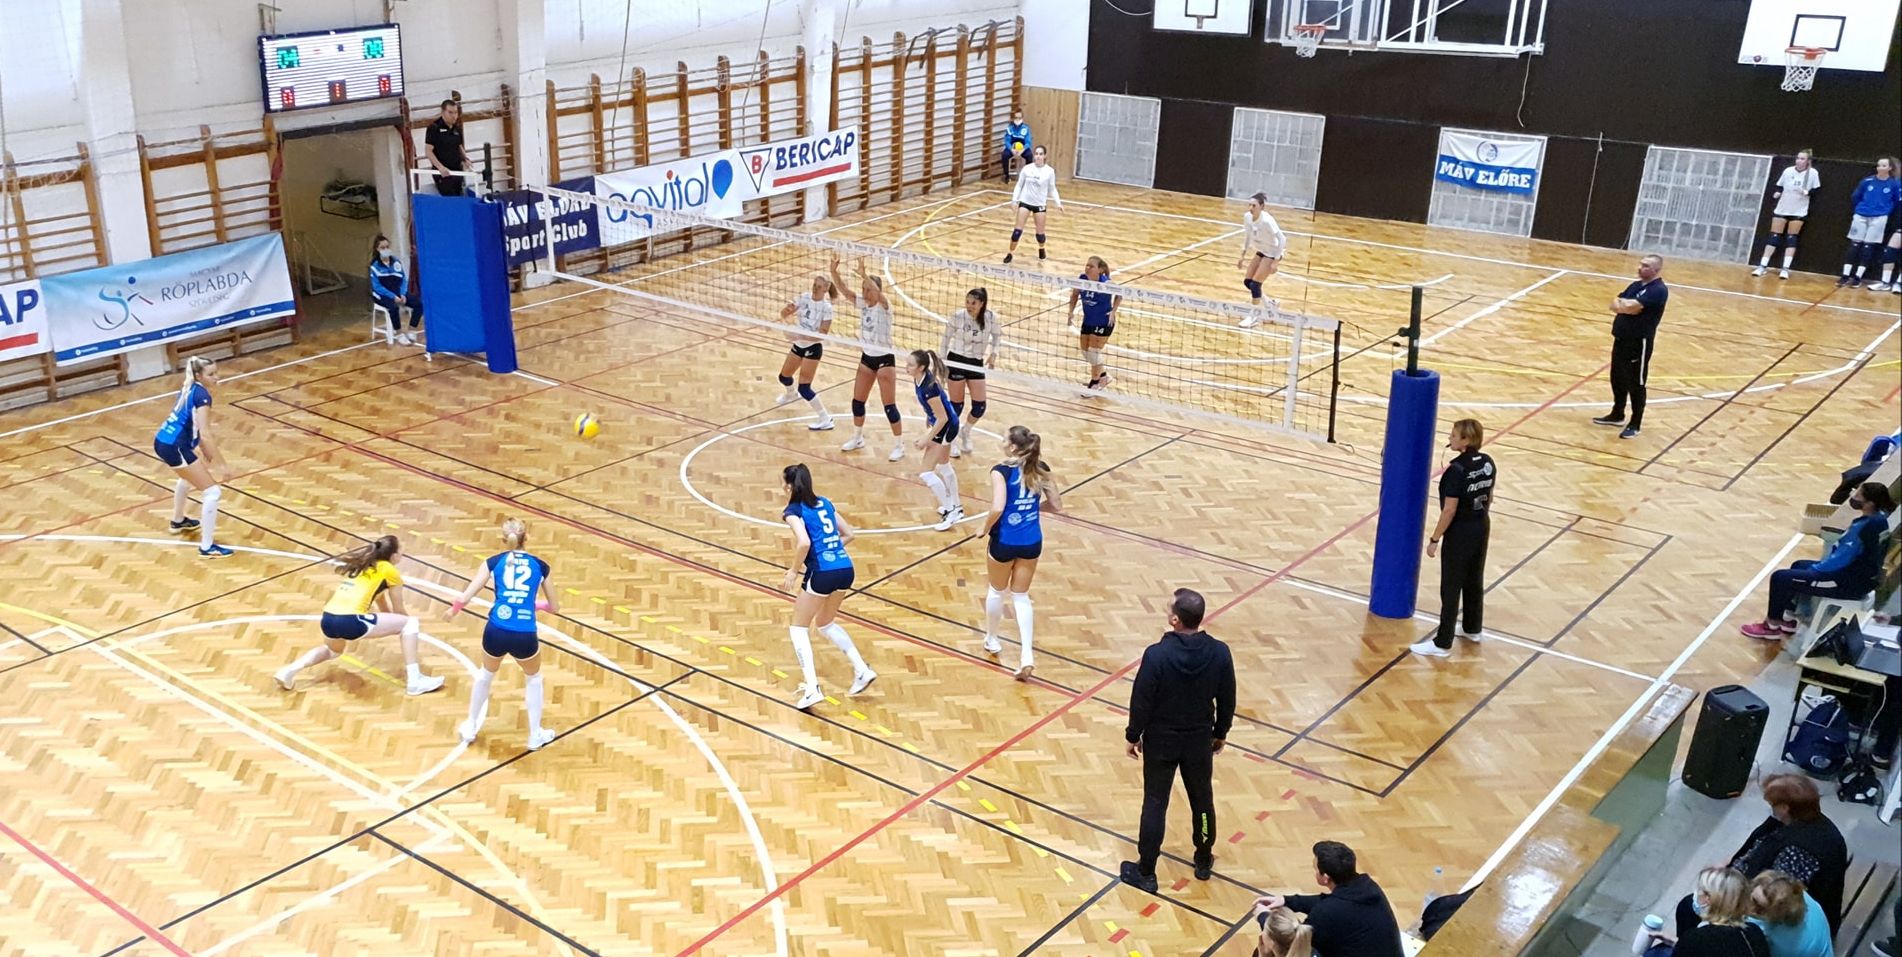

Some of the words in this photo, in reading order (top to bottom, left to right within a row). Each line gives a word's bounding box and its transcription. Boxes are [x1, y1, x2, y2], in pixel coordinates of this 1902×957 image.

[276, 48, 300, 69] 04
[751, 155, 762, 174] B
[775, 131, 855, 170] BERICAP
[1439, 159, 1475, 181] MÁV
[1476, 169, 1532, 188] ELŐRE
[504, 201, 528, 227] ÁV
[552, 219, 588, 243] Club
[161, 270, 253, 302] RÖPLABDA
[817, 510, 834, 534] 5
[503, 564, 532, 591] 12
